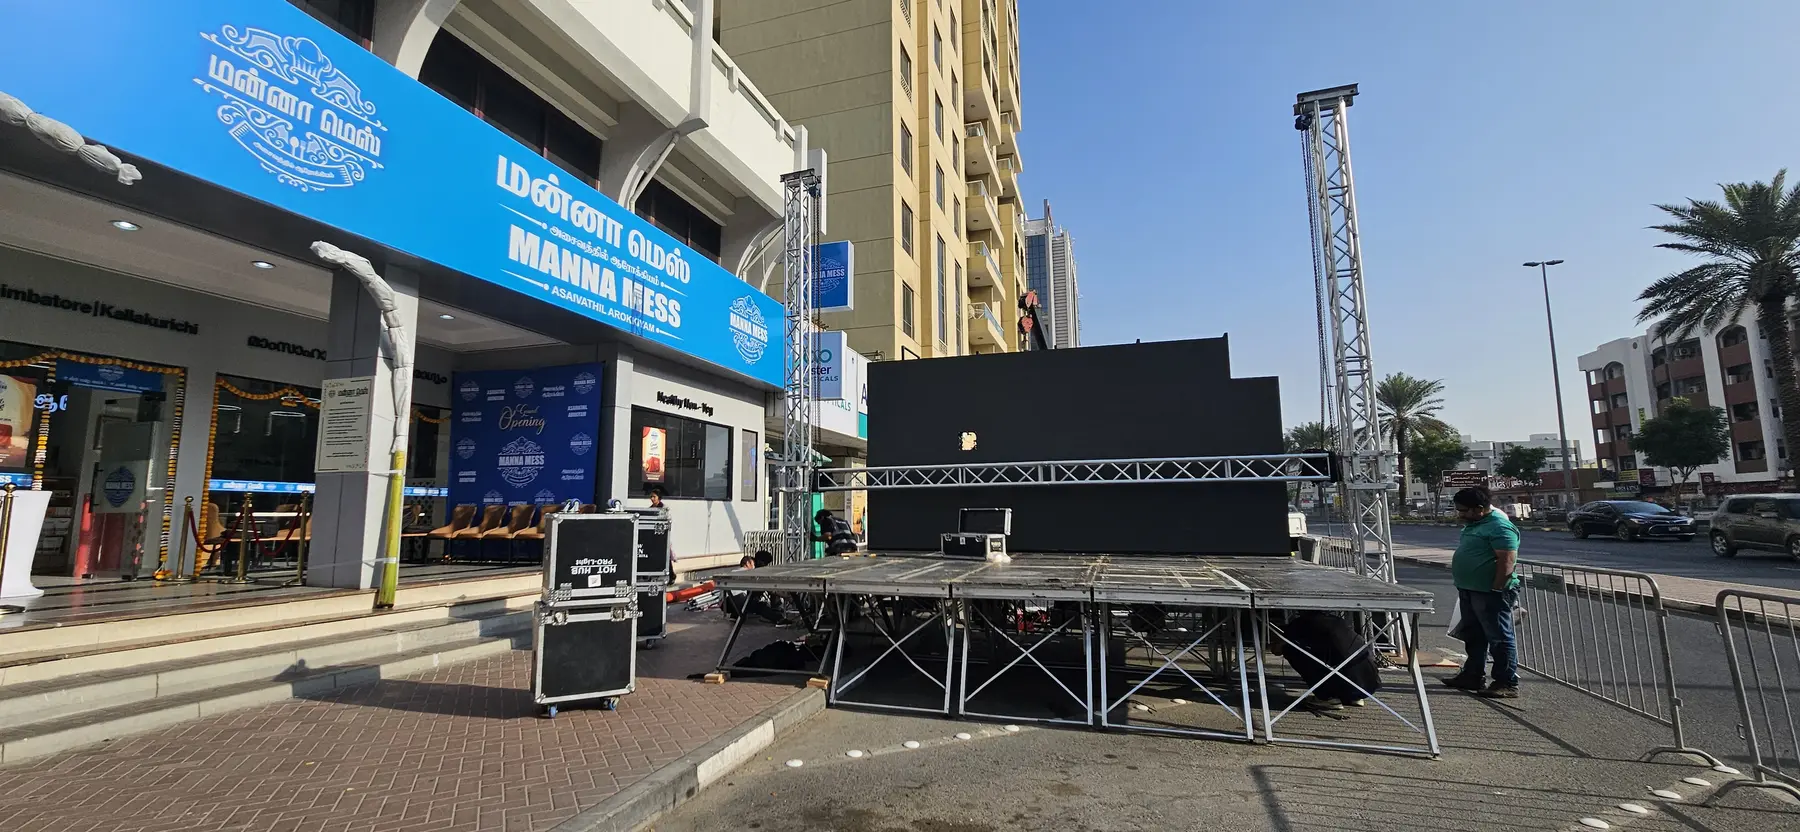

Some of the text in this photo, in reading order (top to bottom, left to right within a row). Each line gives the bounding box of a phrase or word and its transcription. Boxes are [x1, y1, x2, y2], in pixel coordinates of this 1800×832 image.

[208, 54, 381, 157] மன்னா மெஸ்
[496, 154, 690, 284] மன்னா மெஸ்
[549, 225, 660, 286] அசைவத்தில் ஆரோக்கியம்
[508, 224, 681, 328] MANNA MESS
[827, 269, 845, 277] MESS
[551, 286, 655, 333] ASAIVATHIL AROKKIYAM
[730, 312, 768, 343] MANNA MESS
[806, 366, 831, 375] ster
[657, 391, 683, 409] Healthy
[499, 406, 546, 435] Opening
[499, 454, 544, 466] MANNA MESS
[571, 566, 616, 575] HOT HUB
[575, 558, 613, 566] PRO-Light
